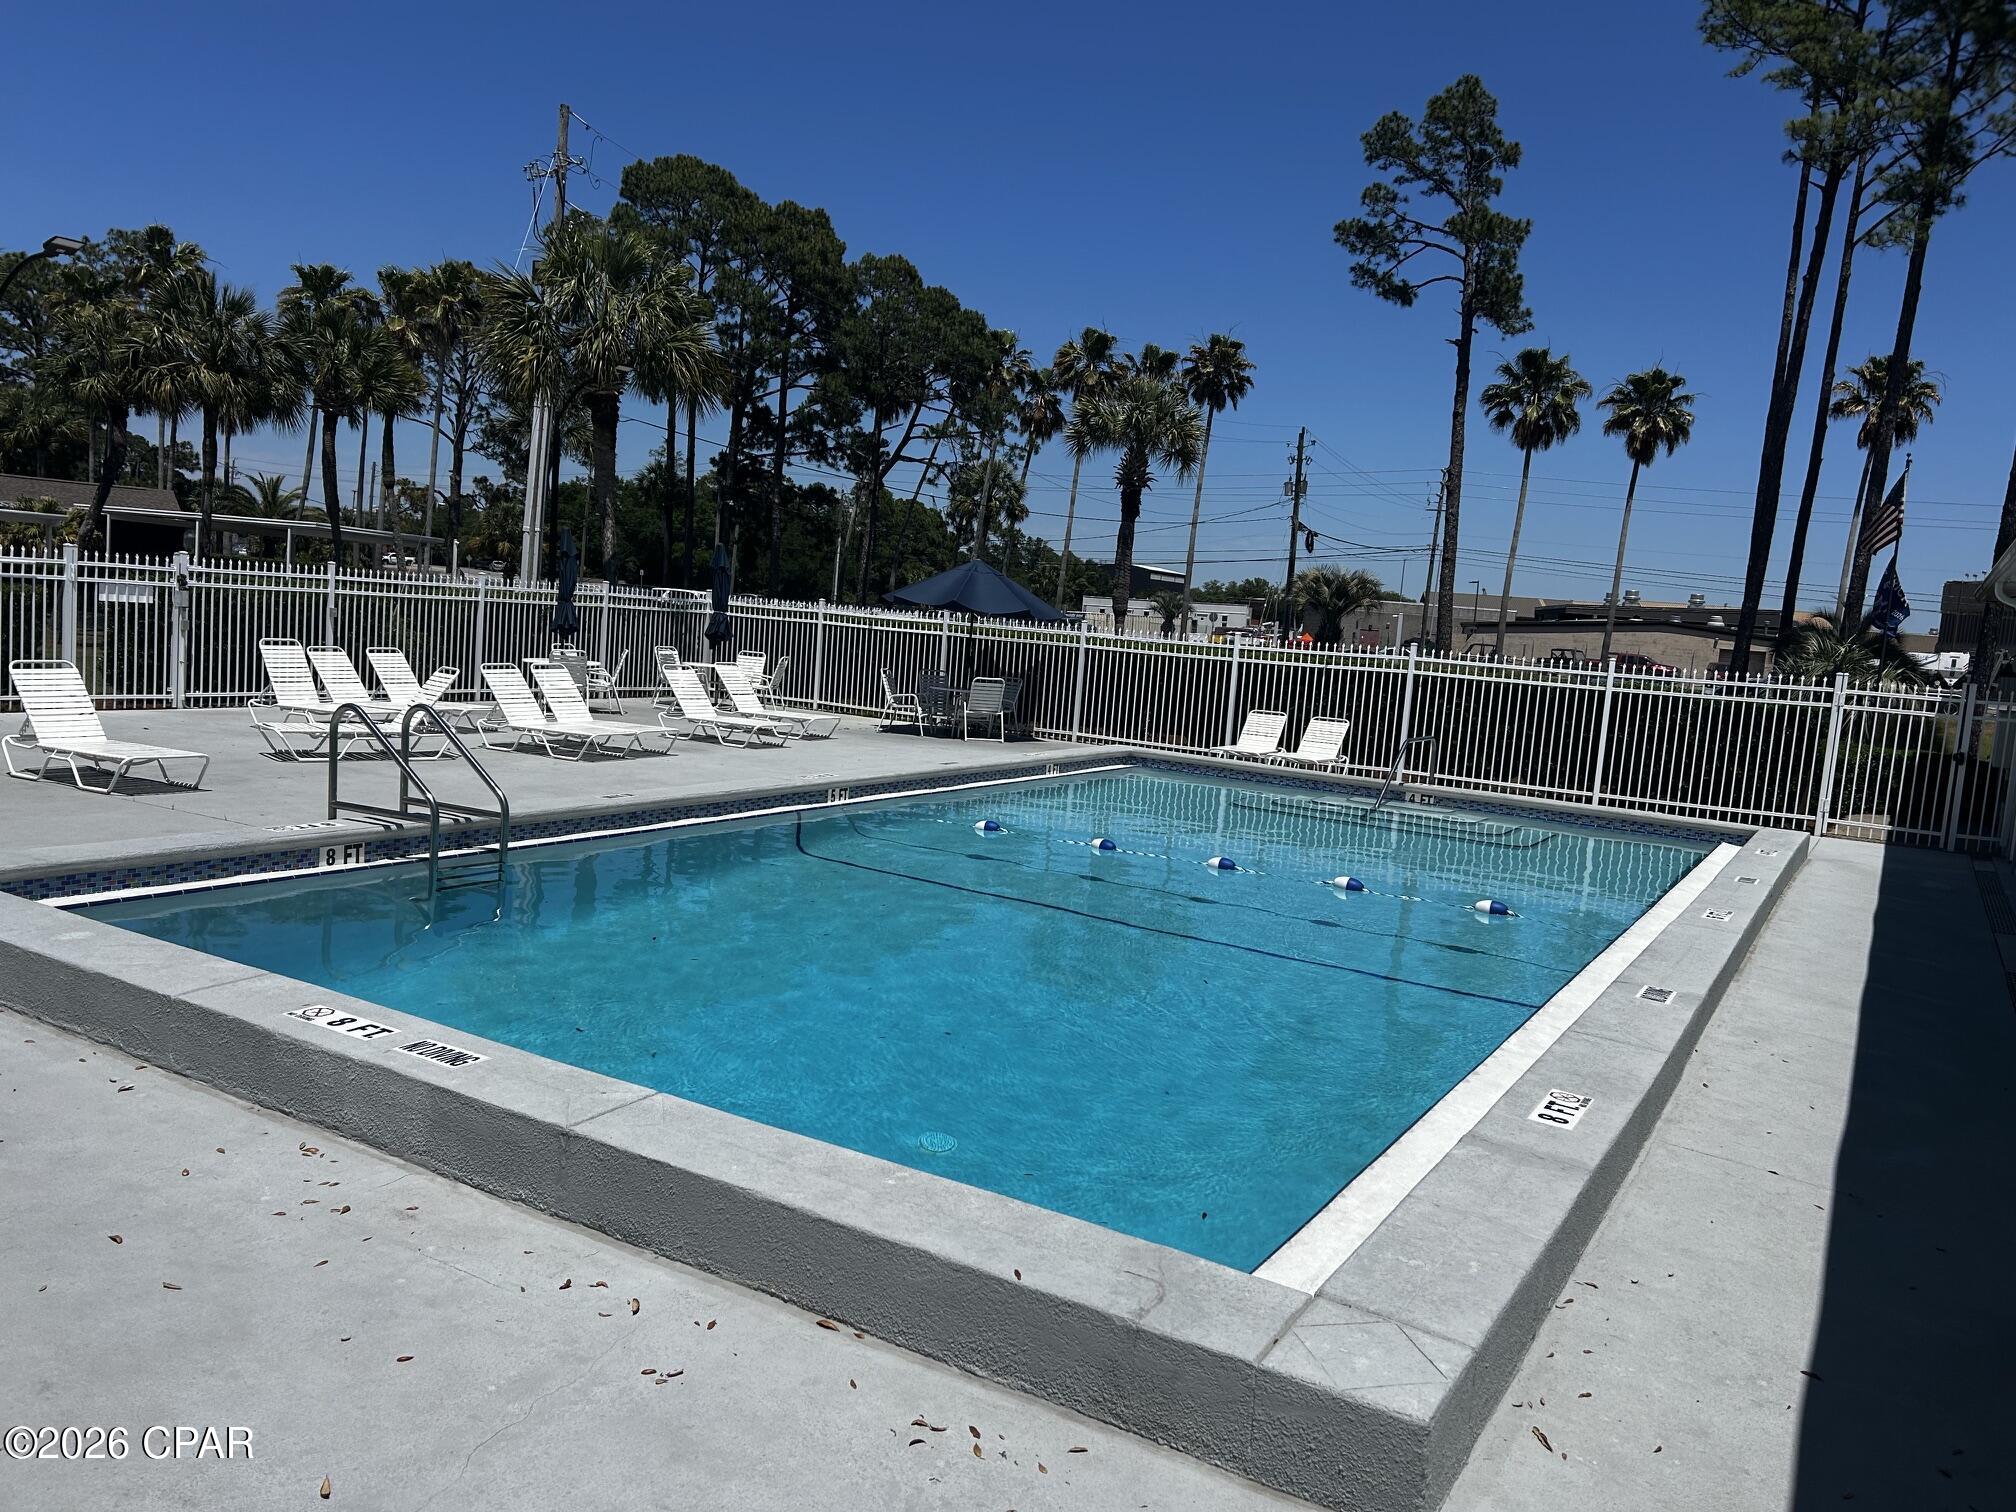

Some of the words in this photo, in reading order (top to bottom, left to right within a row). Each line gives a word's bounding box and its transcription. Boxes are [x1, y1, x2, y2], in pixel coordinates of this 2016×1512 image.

[831, 788, 836, 802] 5
[839, 787, 848, 801] FT
[1408, 793, 1415, 802] 4
[1420, 794, 1433, 804] FT
[326, 848, 336, 866] 8
[343, 843, 363, 864] FT
[326, 1017, 357, 1026] 8
[400, 1040, 438, 1056] NO
[417, 1043, 480, 1067] DIVING
[1538, 1113, 1569, 1124] 8
